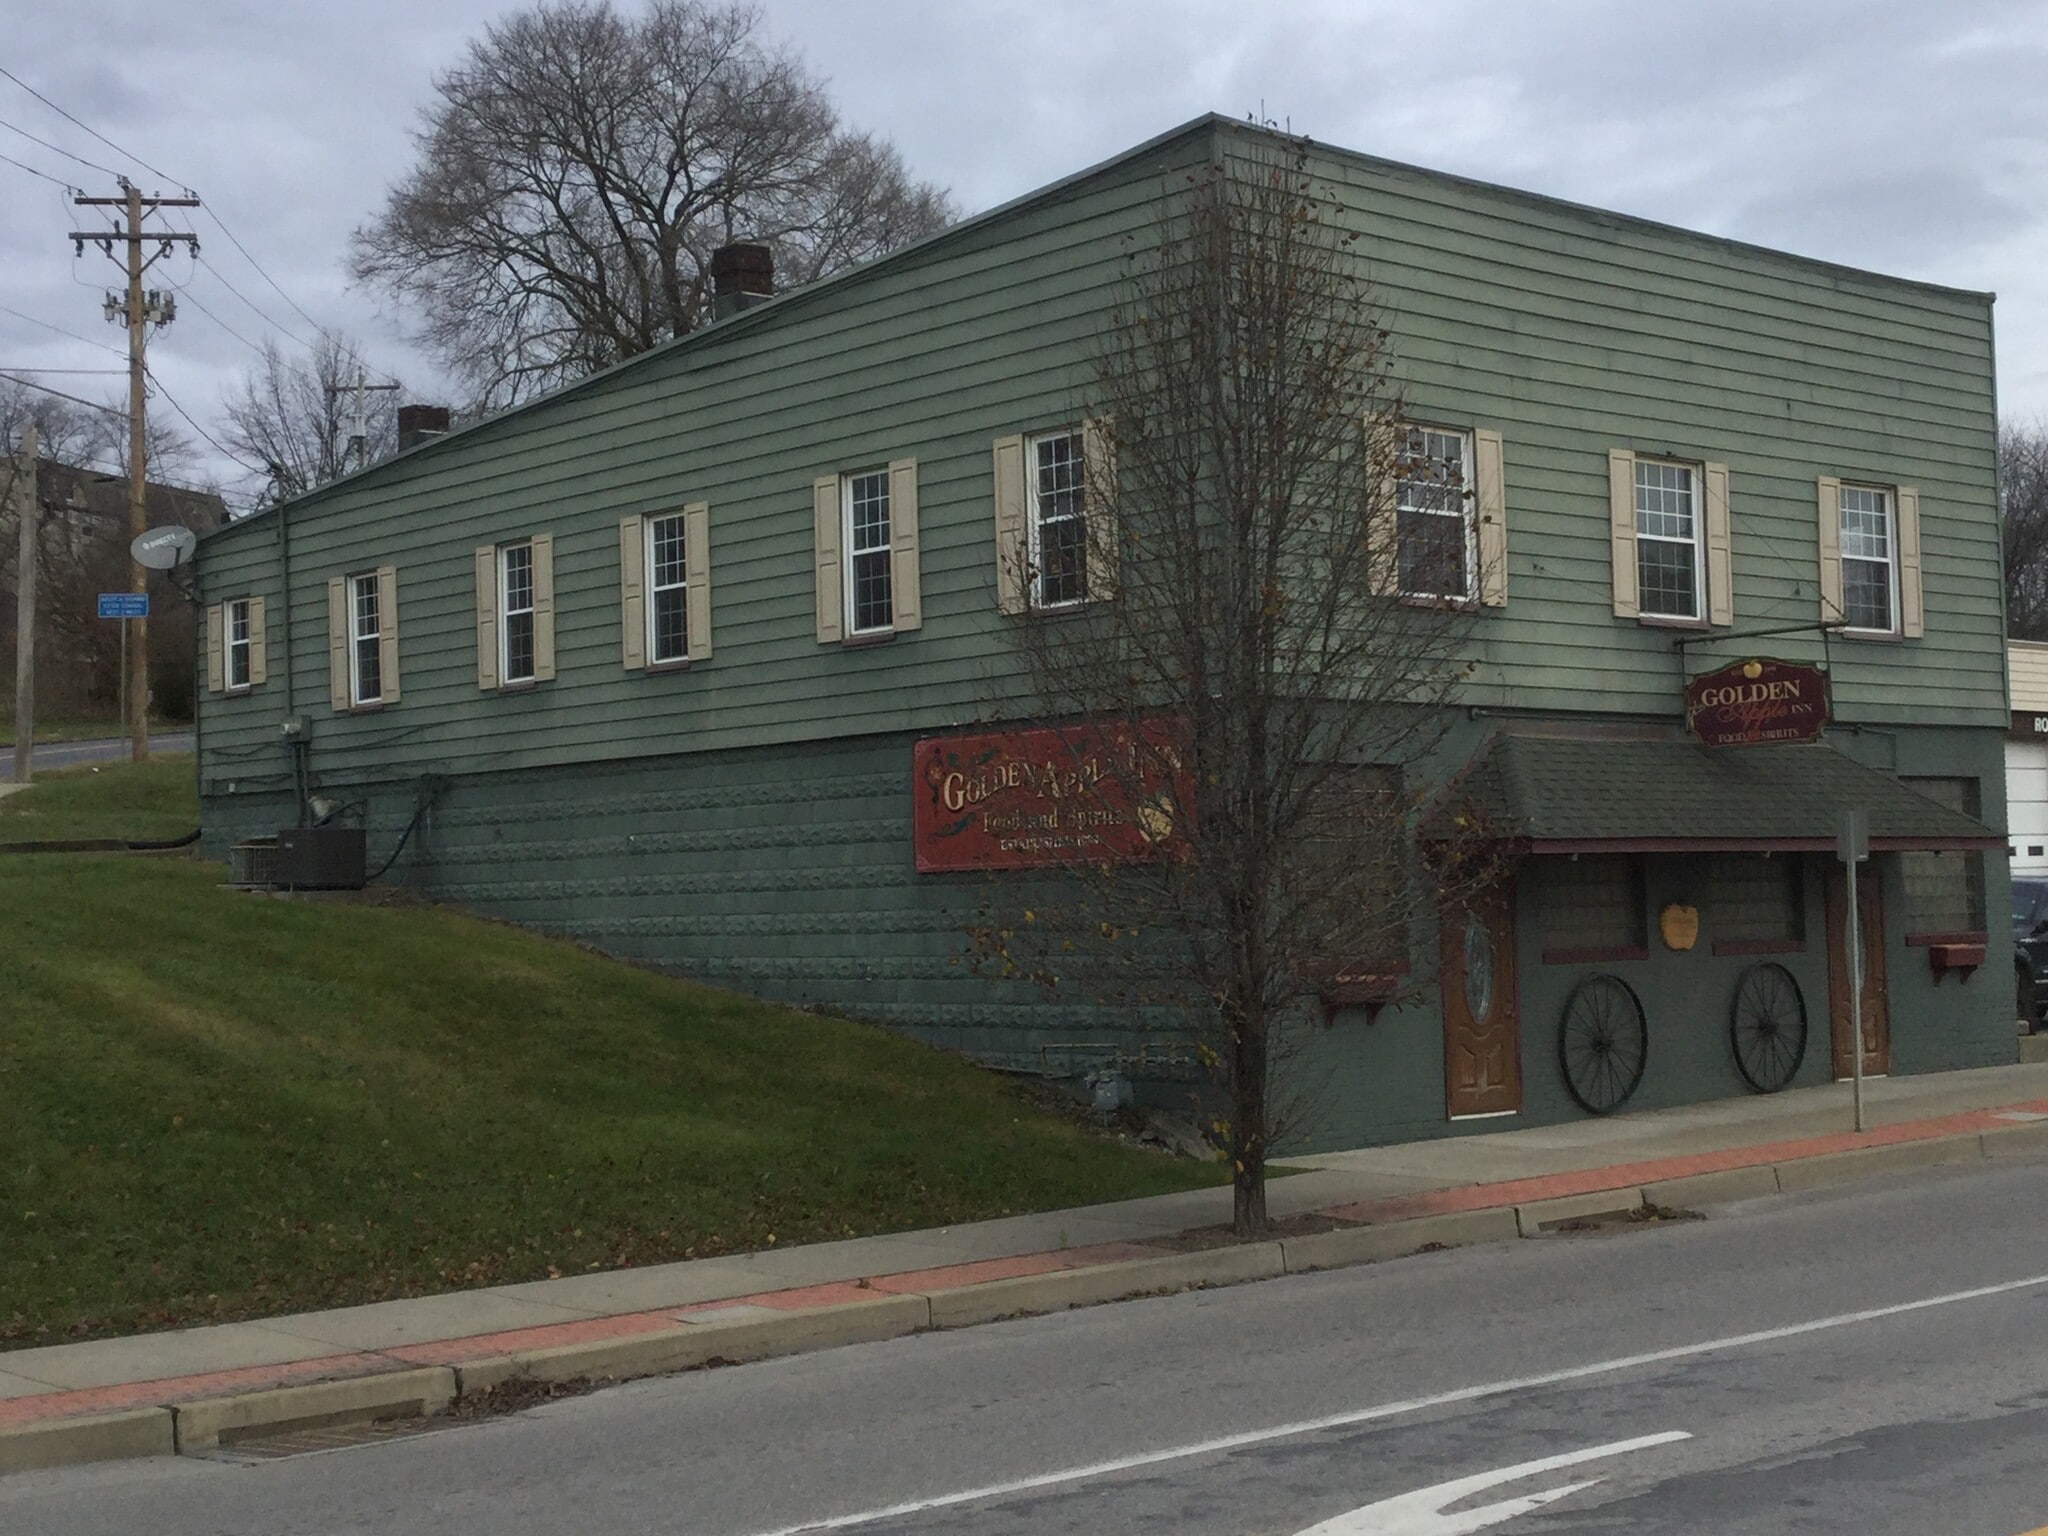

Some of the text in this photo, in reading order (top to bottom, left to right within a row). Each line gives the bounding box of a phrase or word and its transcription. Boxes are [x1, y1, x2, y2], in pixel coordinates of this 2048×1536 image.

[1701, 680, 1800, 707] GOLDEN
[1717, 699, 1812, 738] Apple INN
[1718, 728, 1800, 743] FOOD SPIRITS
